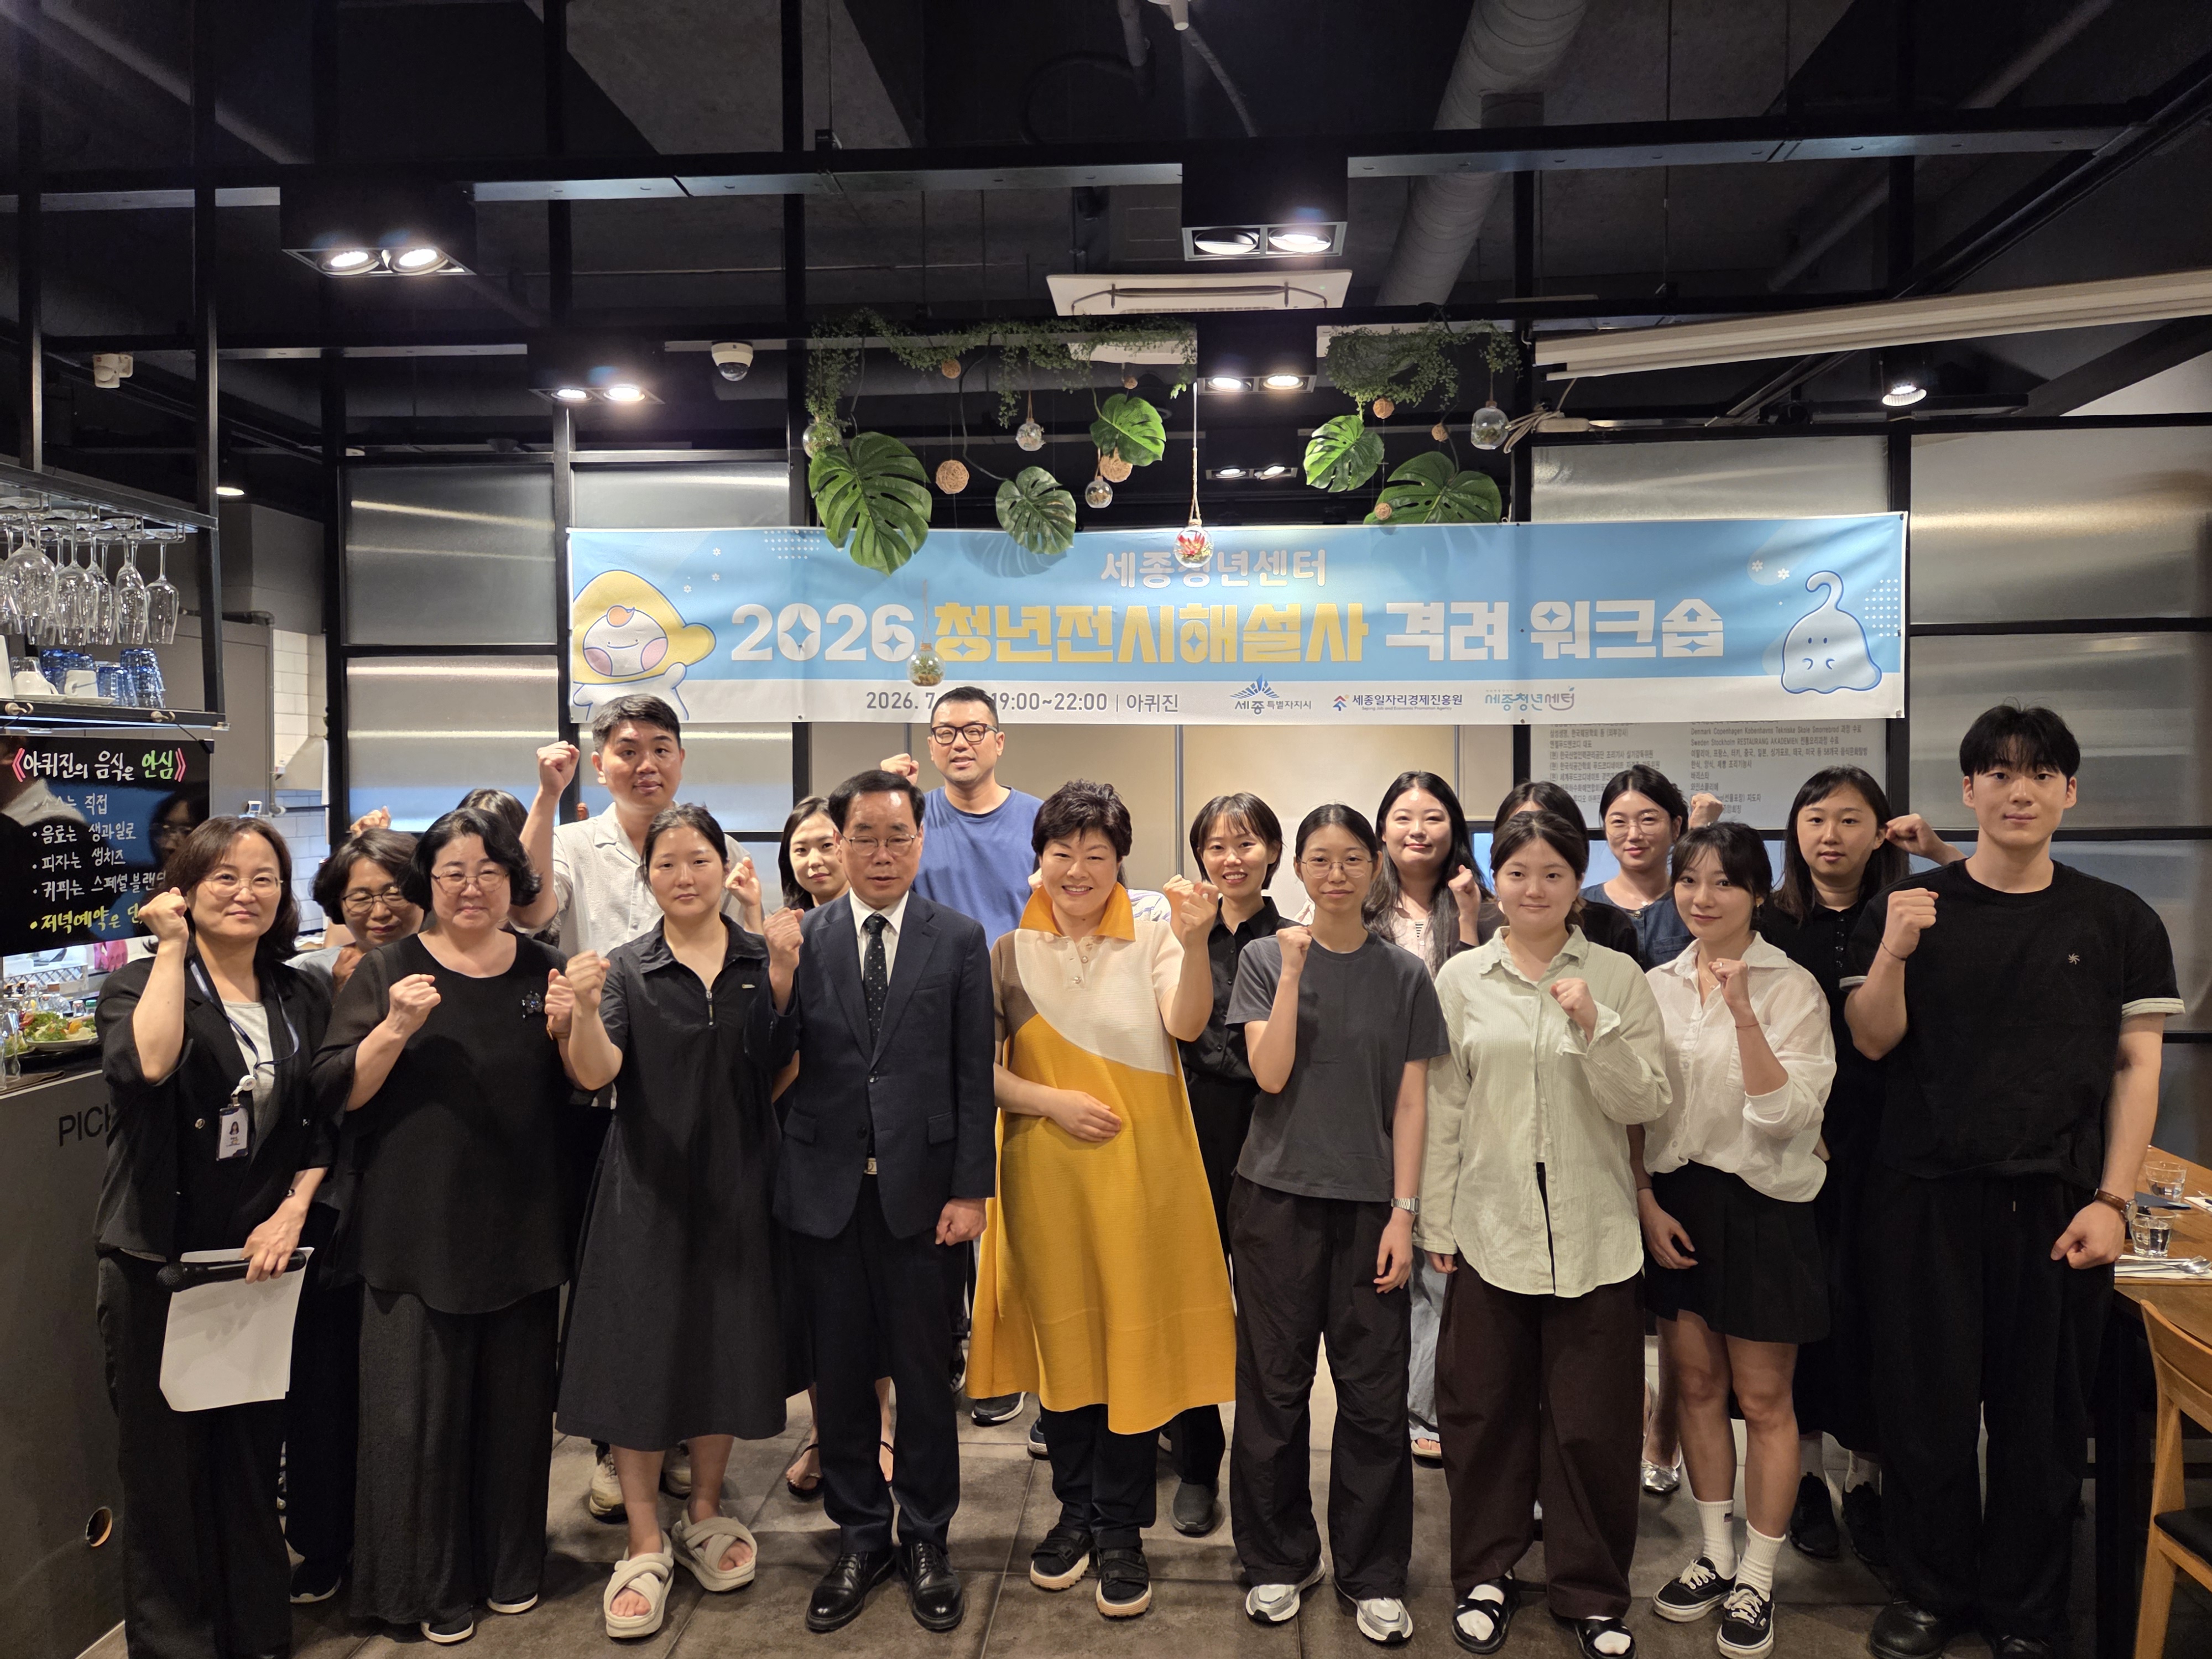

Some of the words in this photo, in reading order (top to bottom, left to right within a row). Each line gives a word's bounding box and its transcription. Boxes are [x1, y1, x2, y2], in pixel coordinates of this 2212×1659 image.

[732, 603, 916, 662] 2026
[935, 602, 1369, 663] 청년전시해설사
[1386, 602, 1509, 661] 격려
[1530, 599, 1724, 660] 워크숍
[866, 691, 919, 709] 2026.
[1126, 693, 1179, 713] 아퀴진
[1352, 694, 1463, 706] 세종일자리경제진흥원
[1485, 692, 1575, 711] 세종청년센터
[94, 750, 135, 781] 음식은
[42, 795, 77, 813] 소스는
[85, 792, 108, 816] 직접
[41, 825, 77, 844] 음료는
[88, 821, 137, 842] 생과일로
[41, 852, 82, 873] 피자는
[91, 847, 126, 866] 생치즈
[41, 905, 121, 934] 저녁예약은
